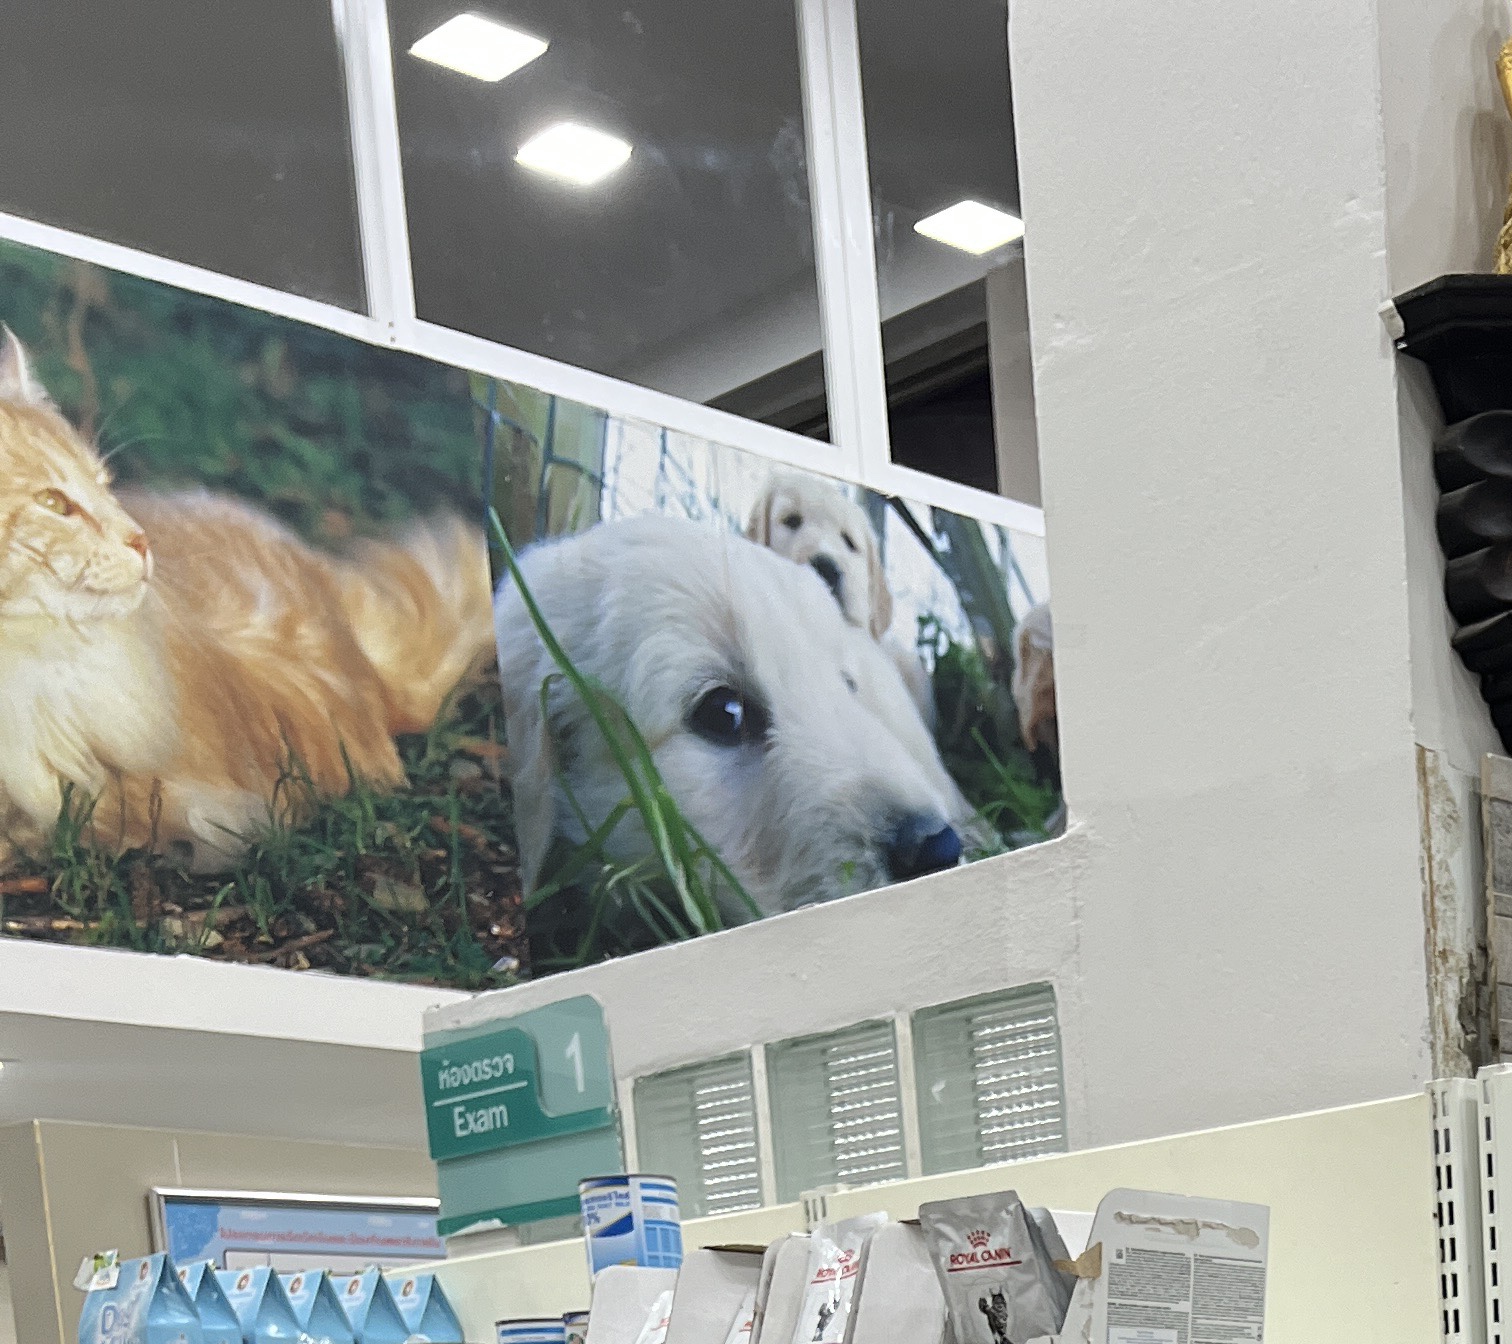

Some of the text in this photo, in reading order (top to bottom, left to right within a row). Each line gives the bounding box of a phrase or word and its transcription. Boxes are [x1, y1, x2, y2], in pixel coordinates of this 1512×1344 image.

[438, 1052, 514, 1089] ห้องตรวจ
[566, 1032, 585, 1092] 1
[453, 1104, 508, 1137] Exam
